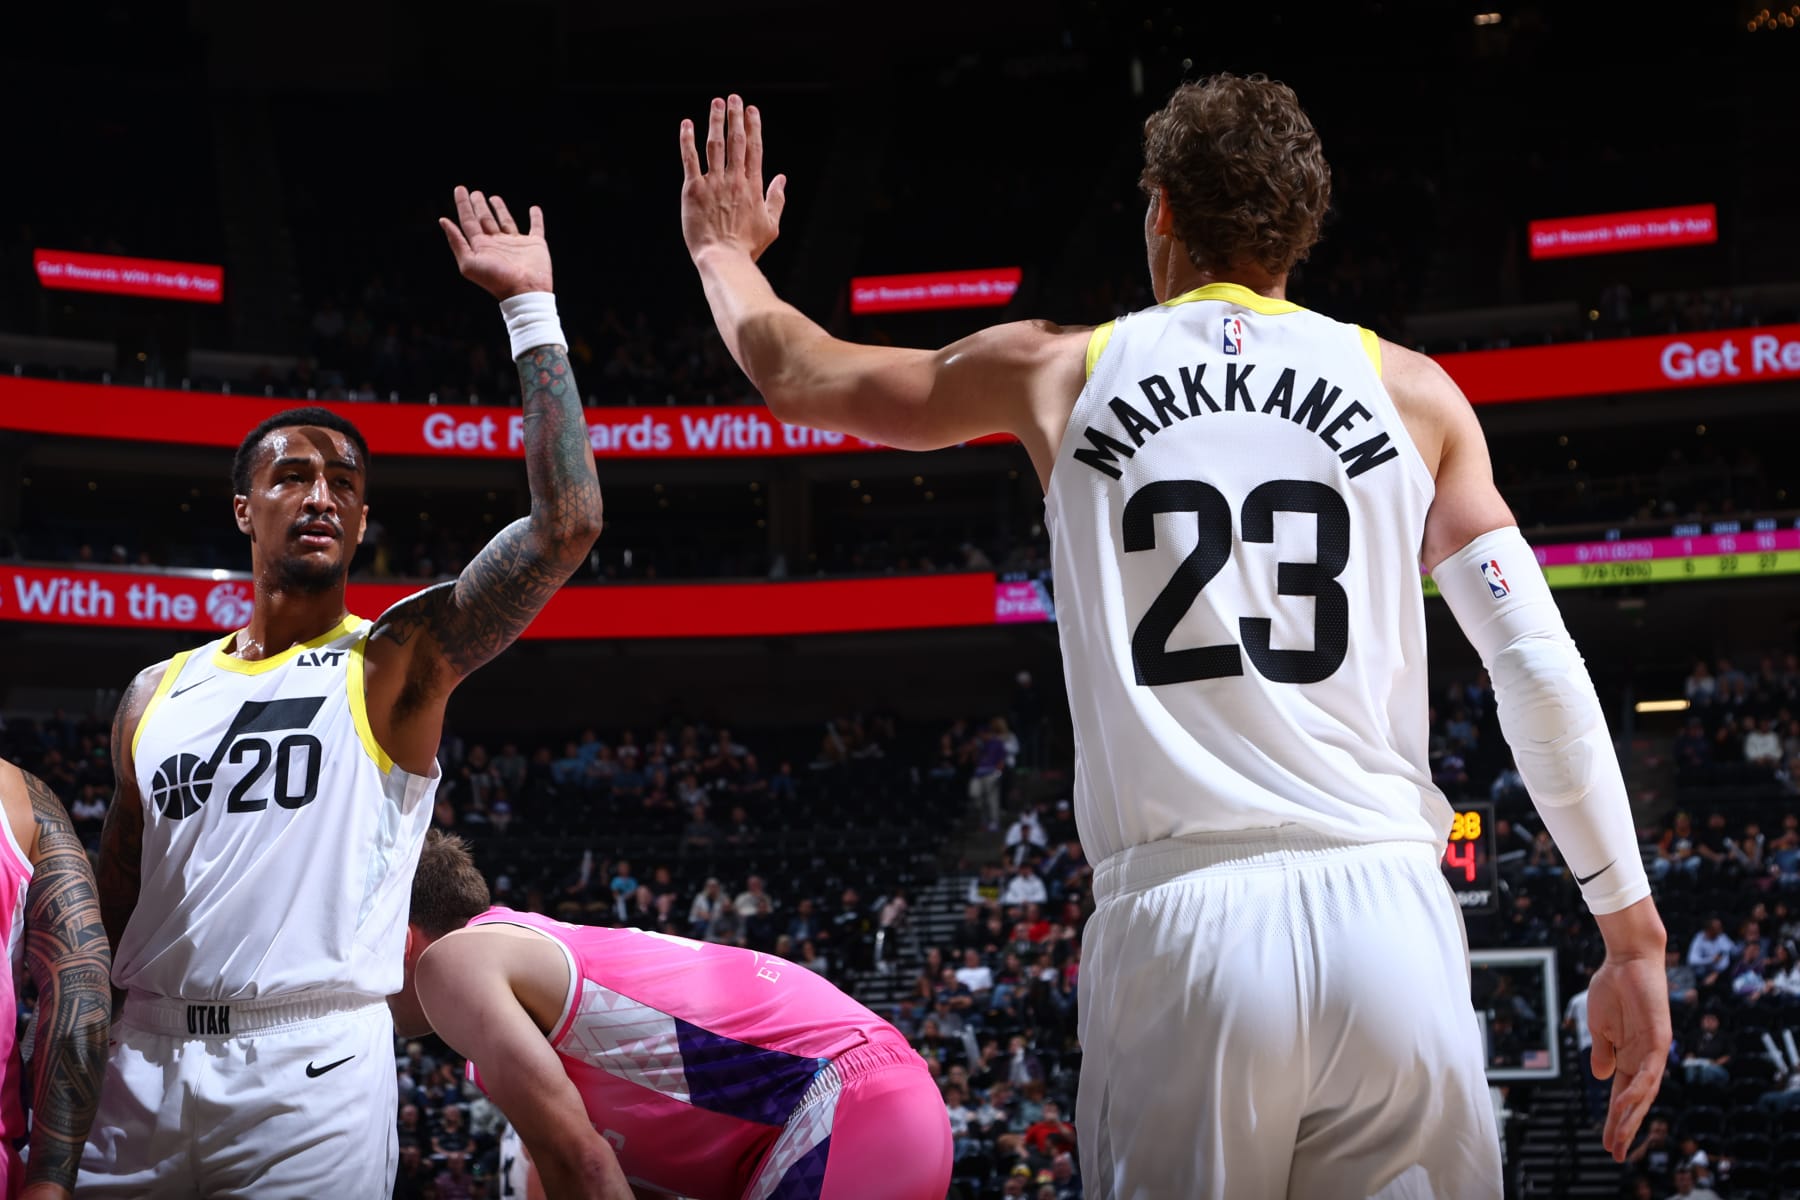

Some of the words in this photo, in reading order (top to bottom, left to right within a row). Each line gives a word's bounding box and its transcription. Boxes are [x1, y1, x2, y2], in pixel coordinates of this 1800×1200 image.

[1660, 339, 1741, 380] Get
[422, 412, 497, 449] Get
[681, 413, 773, 450] With
[1073, 363, 1399, 480] MARKKANEN
[13, 574, 115, 618] With
[127, 582, 198, 623] the
[1122, 479, 1351, 686] 23
[296, 651, 346, 667] LVT
[227, 734, 322, 814] 20
[187, 1005, 230, 1035] UTAH
